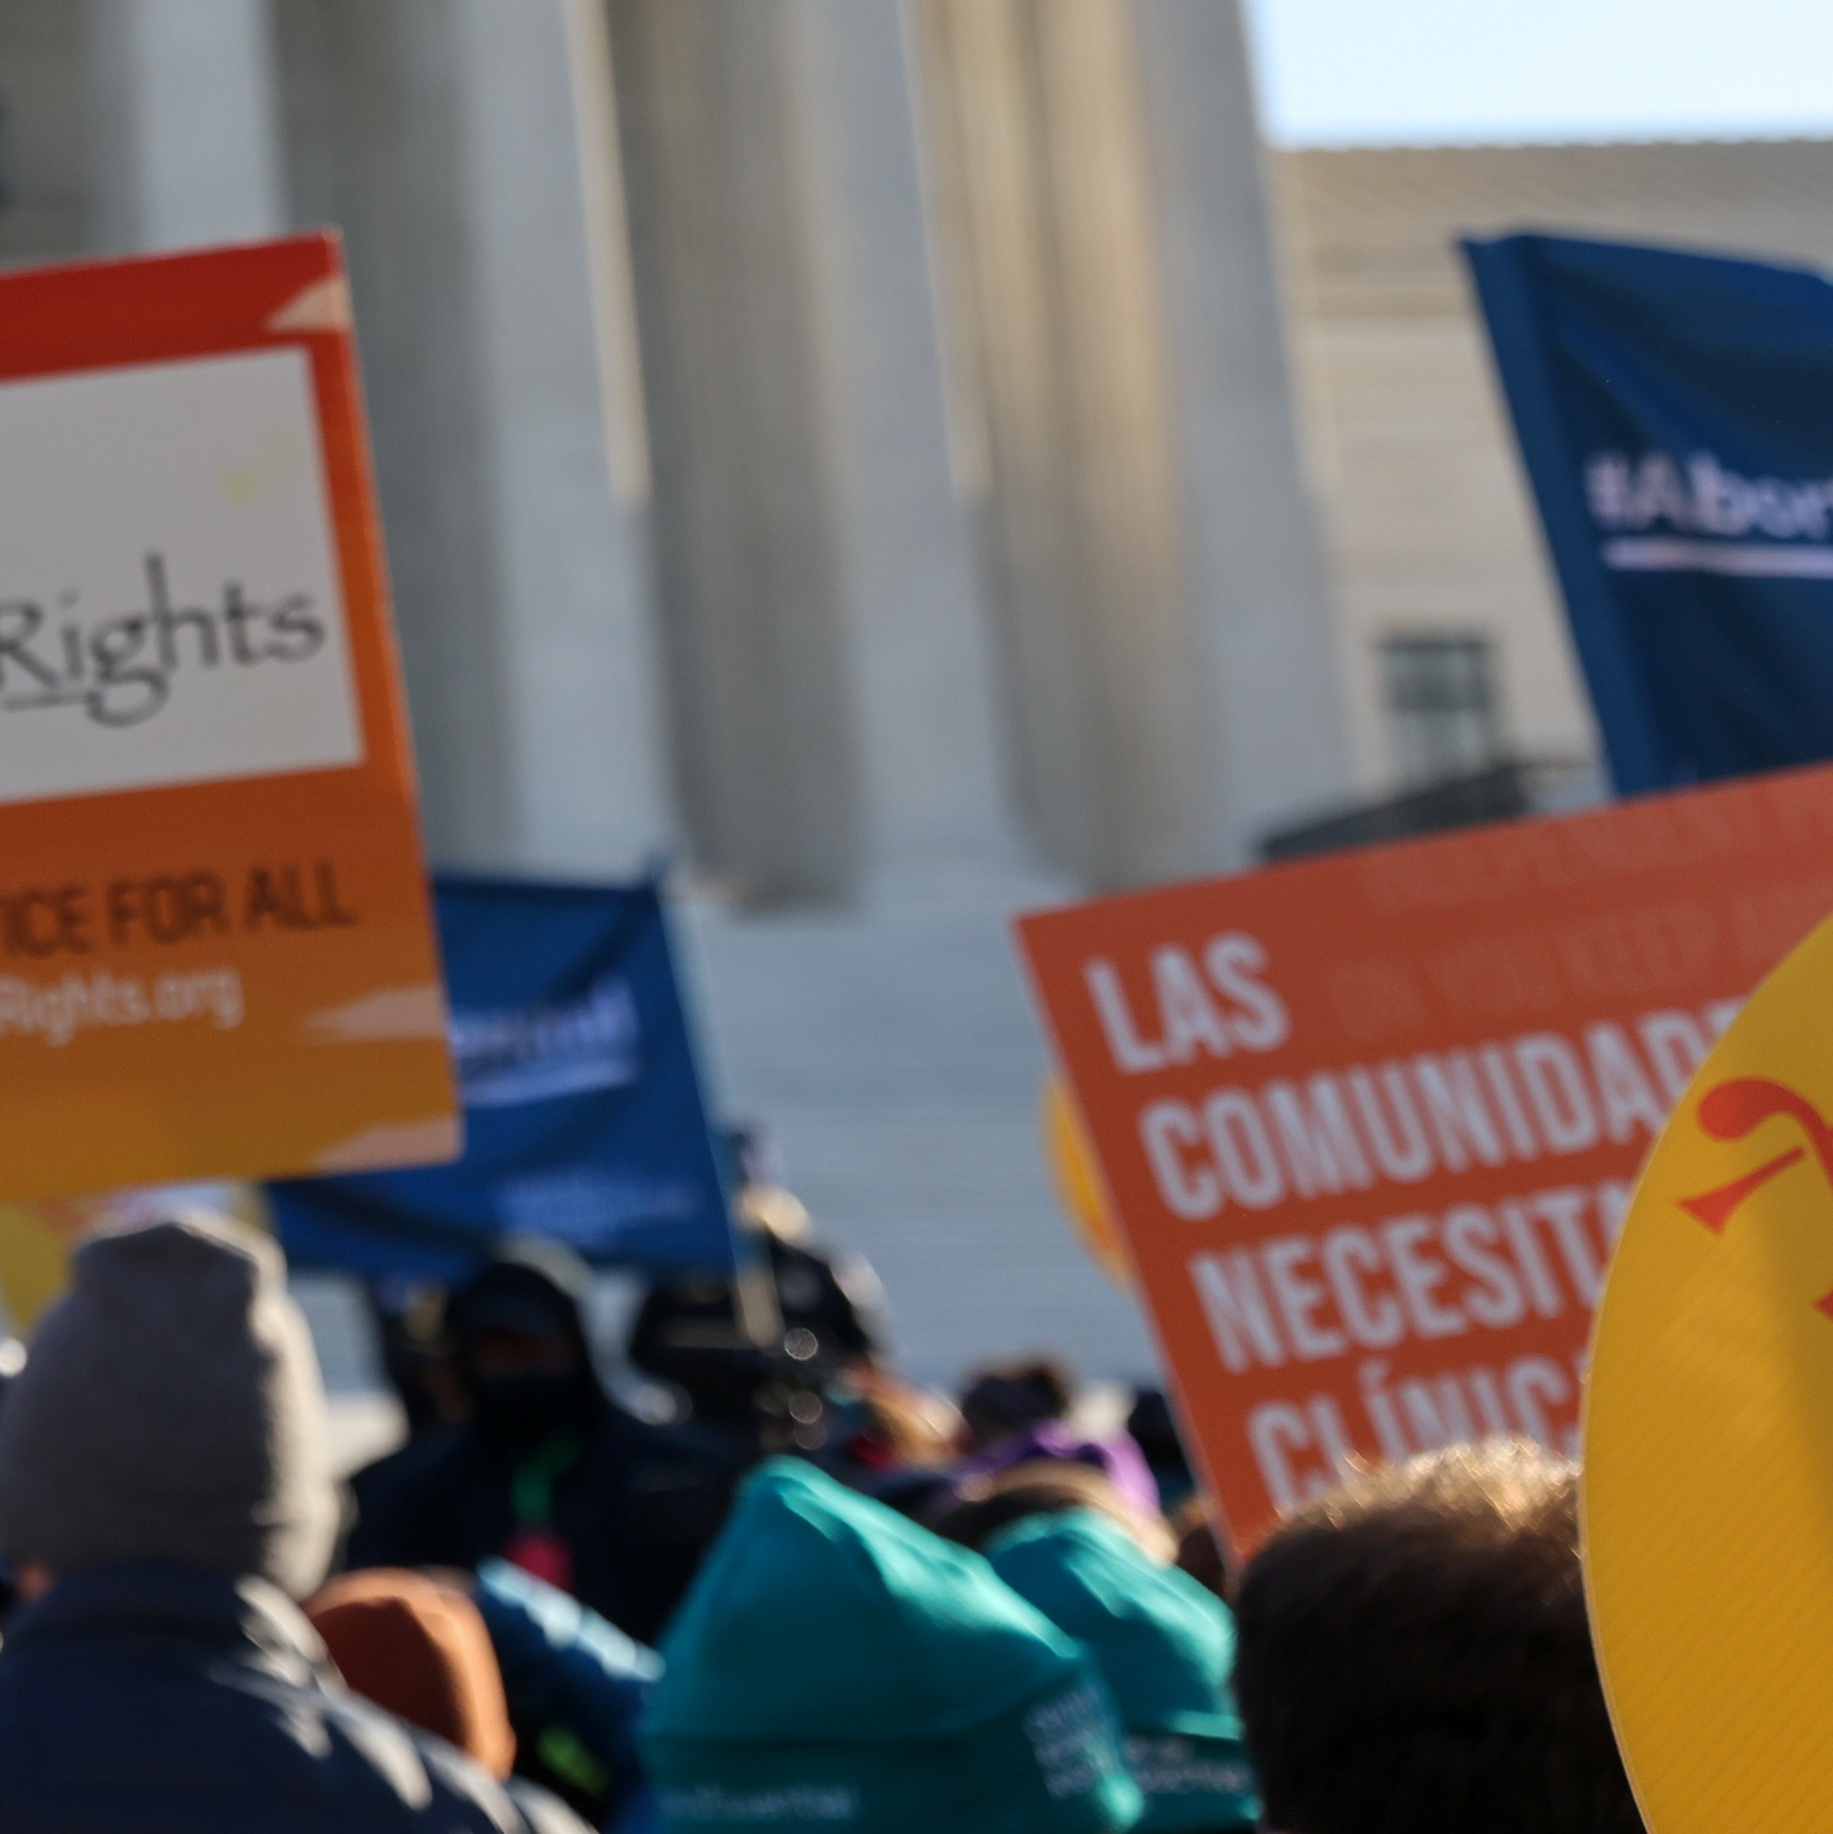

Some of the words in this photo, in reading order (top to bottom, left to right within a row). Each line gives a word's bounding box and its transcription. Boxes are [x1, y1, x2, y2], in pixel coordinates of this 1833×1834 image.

[107, 870, 231, 945] FOR
[245, 862, 360, 934] ALL
[1083, 931, 1293, 1076] LAS
[1137, 995, 1745, 1222] COMUNIDAD
[1244, 1349, 1587, 1516] CLÍNIC
